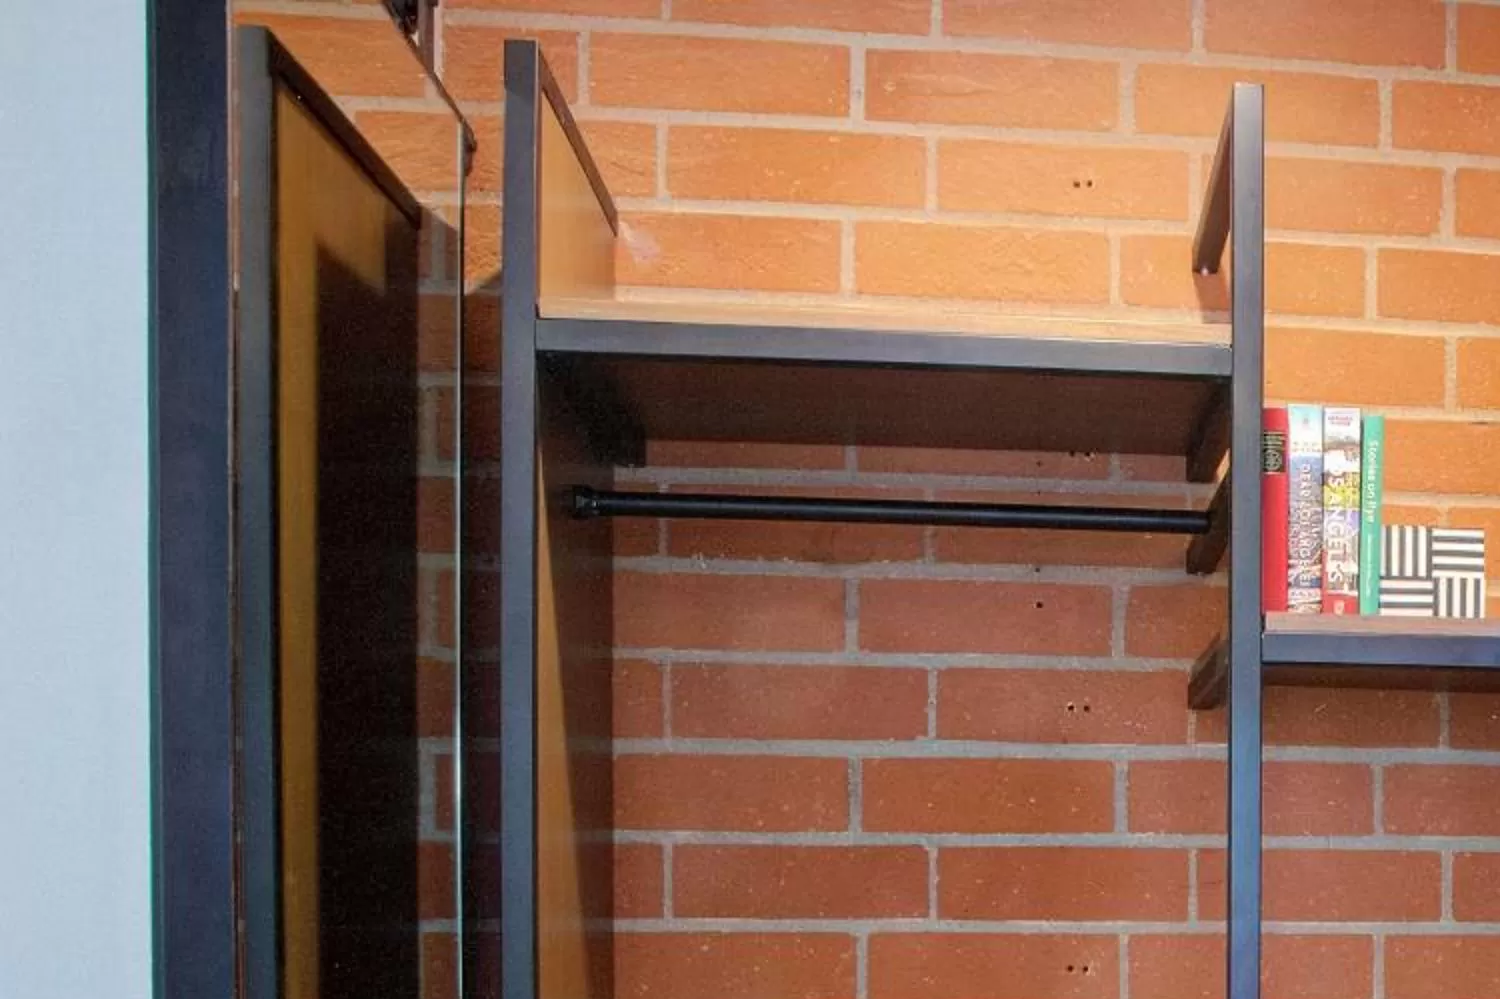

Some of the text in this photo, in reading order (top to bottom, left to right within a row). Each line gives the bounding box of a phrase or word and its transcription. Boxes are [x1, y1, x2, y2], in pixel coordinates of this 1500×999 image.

[1367, 440, 1379, 481] Stories
[1299, 464, 1311, 497] DEAR
[1367, 483, 1376, 499] on
[1299, 501, 1310, 526] LOS
[1327, 493, 1345, 582] ANGELES
[1298, 531, 1310, 586] ANGELES
